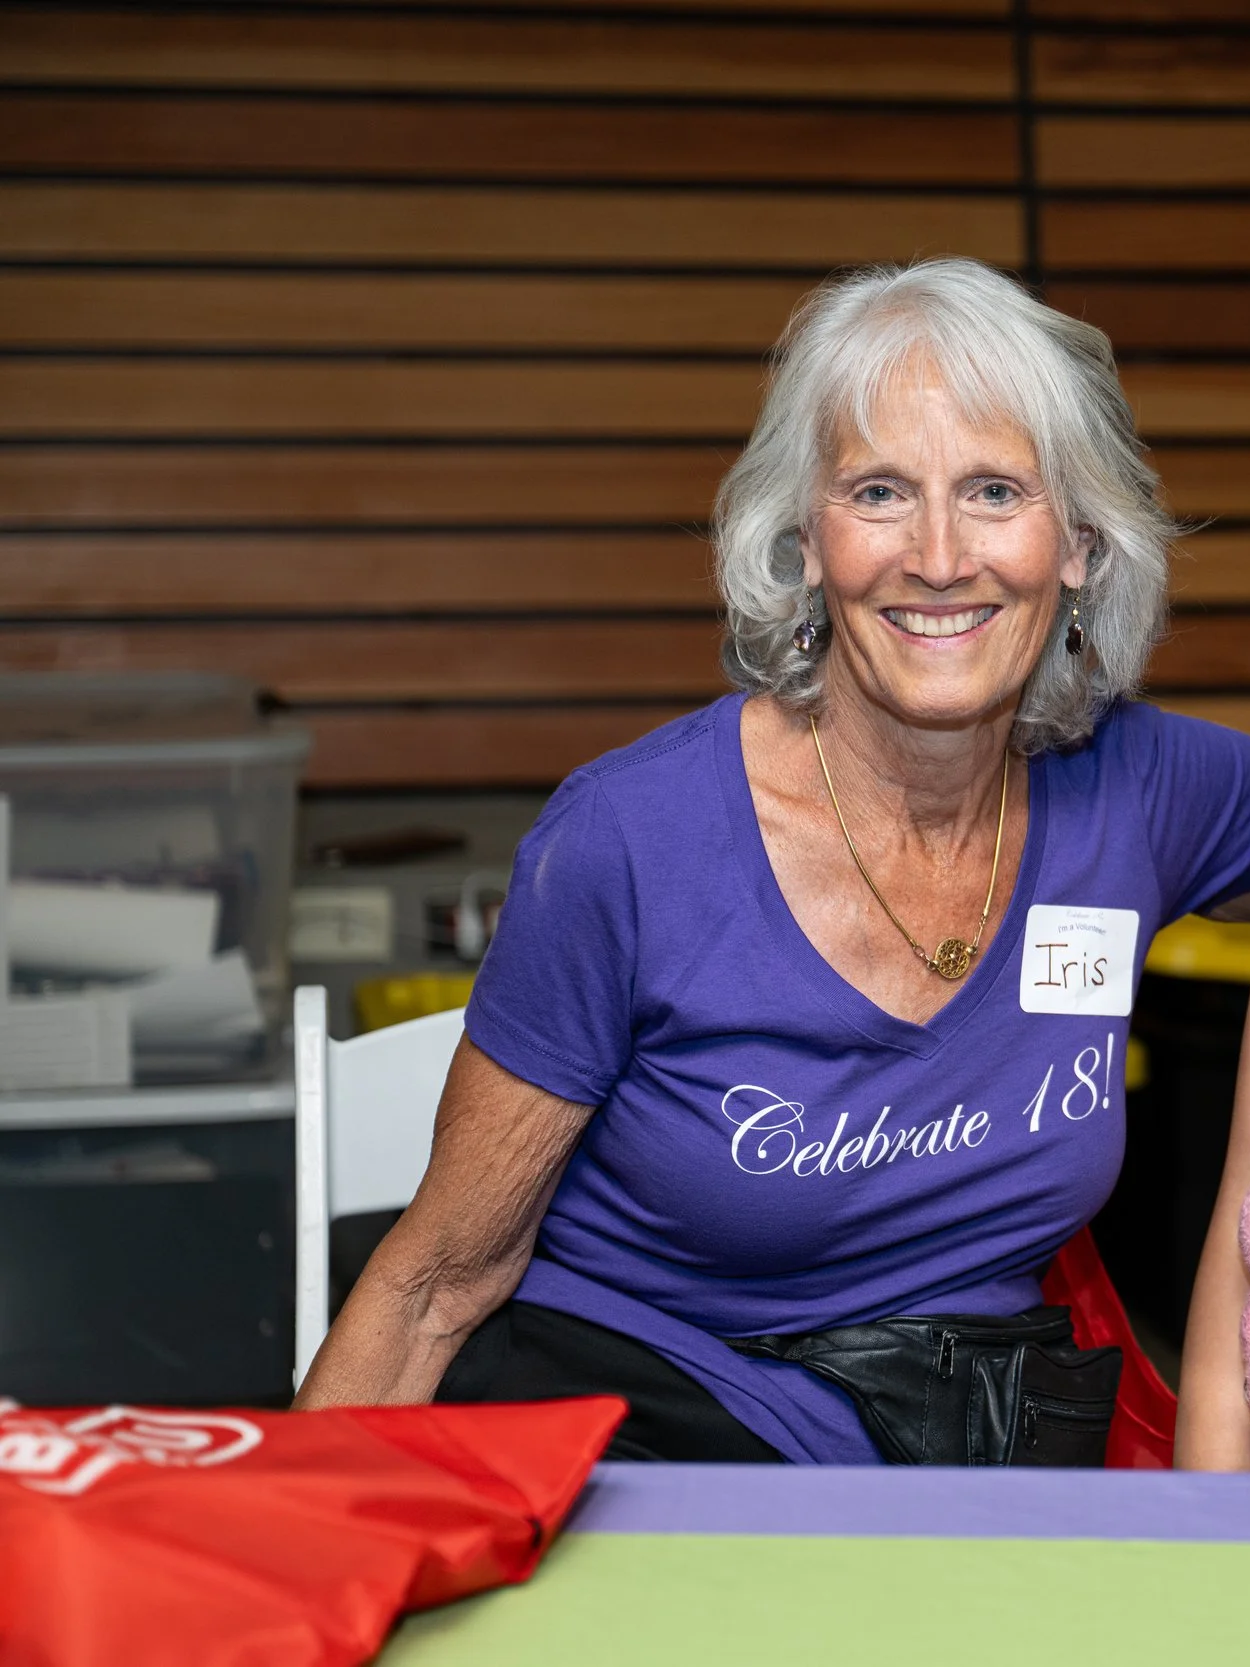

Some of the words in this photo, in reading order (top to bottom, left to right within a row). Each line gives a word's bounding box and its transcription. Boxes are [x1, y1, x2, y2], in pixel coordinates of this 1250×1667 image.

[1034, 943, 1107, 988] Iris
[721, 1084, 991, 1177] Celebrate
[1022, 1032, 1114, 1133] 18!
